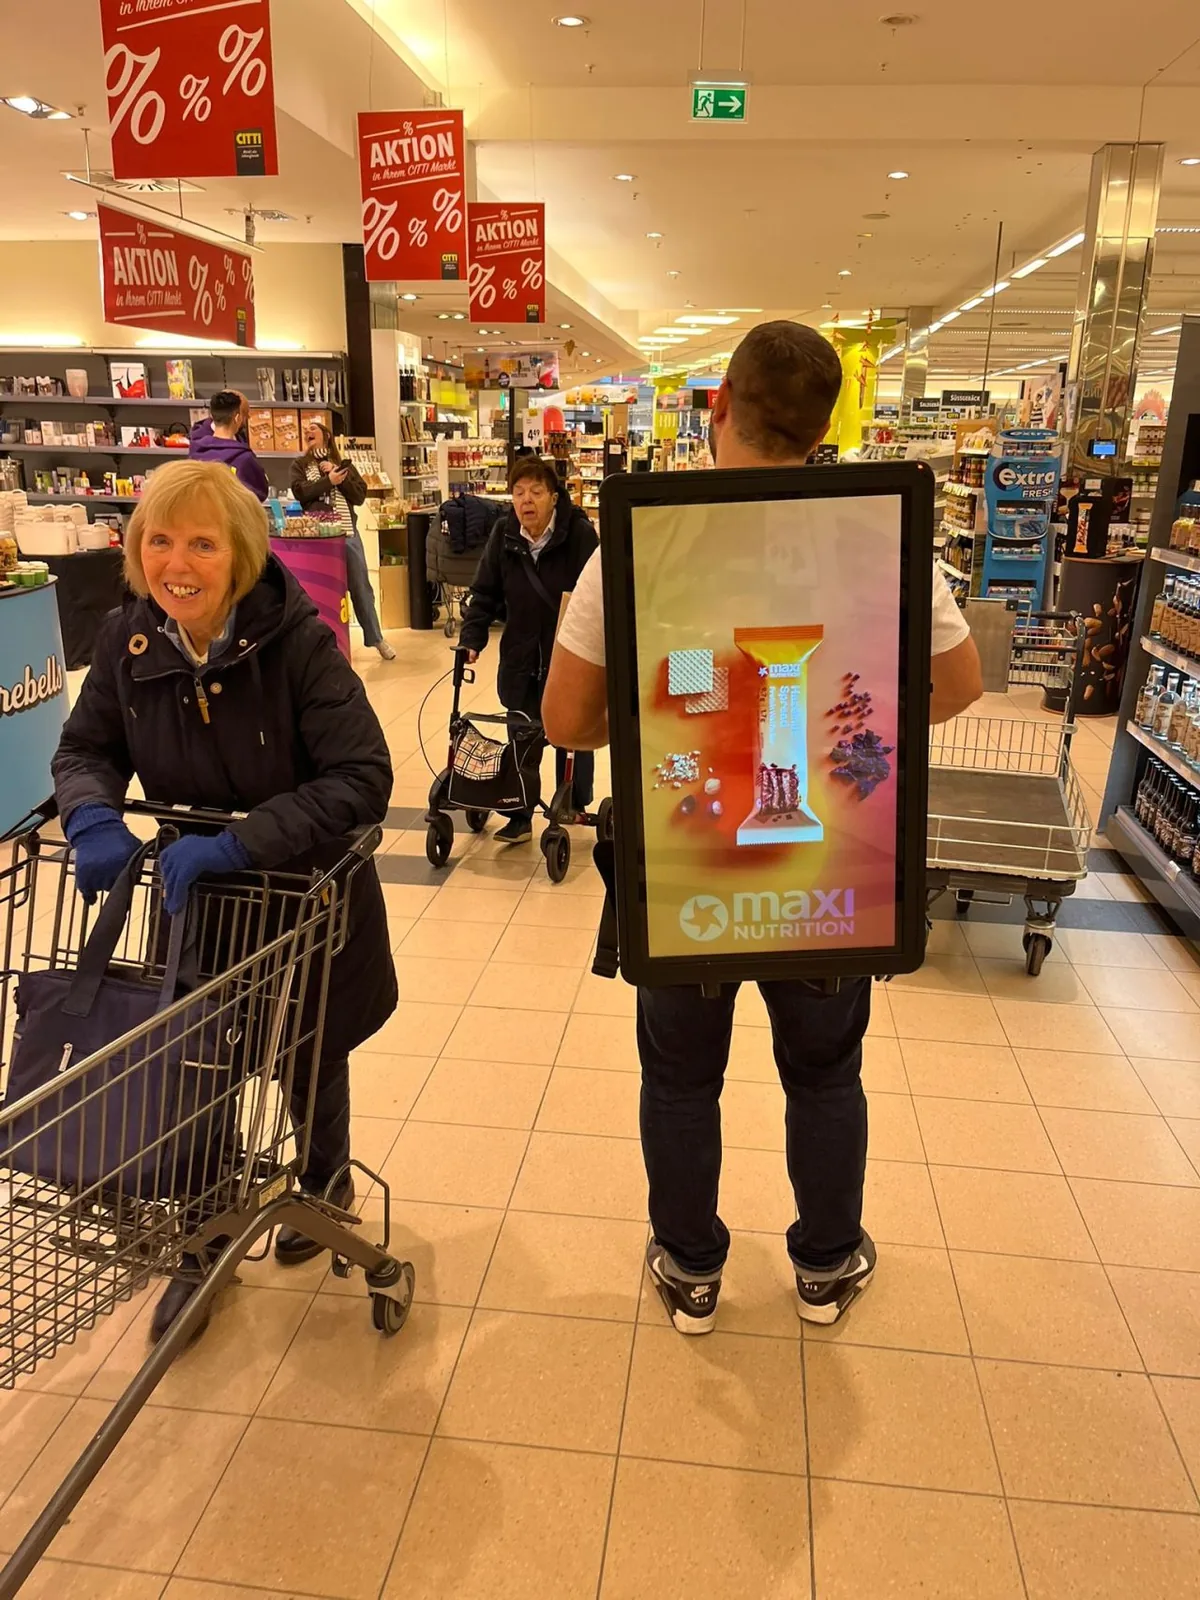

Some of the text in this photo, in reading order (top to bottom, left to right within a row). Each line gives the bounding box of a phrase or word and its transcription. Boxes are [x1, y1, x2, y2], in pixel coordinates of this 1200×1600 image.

[119, 1, 133, 15] in
[179, 74, 212, 121] %
[218, 24, 267, 96] %
[236, 132, 262, 145] CITTI
[370, 131, 455, 168] AKTION
[382, 168, 406, 180] Ihrem
[407, 163, 430, 176] CITTI
[430, 160, 457, 173] Markt
[408, 217, 428, 247] %
[432, 188, 462, 233] %
[475, 218, 538, 243] AKTION
[503, 239, 519, 249] CITTI
[113, 246, 180, 287] AKTION
[502, 278, 517, 300] %
[521, 258, 543, 290] %
[147, 290, 164, 306] CITTI
[999, 468, 1056, 486] extra
[1022, 488, 1054, 498] FRESH
[733, 920, 855, 941] NUTRITION
